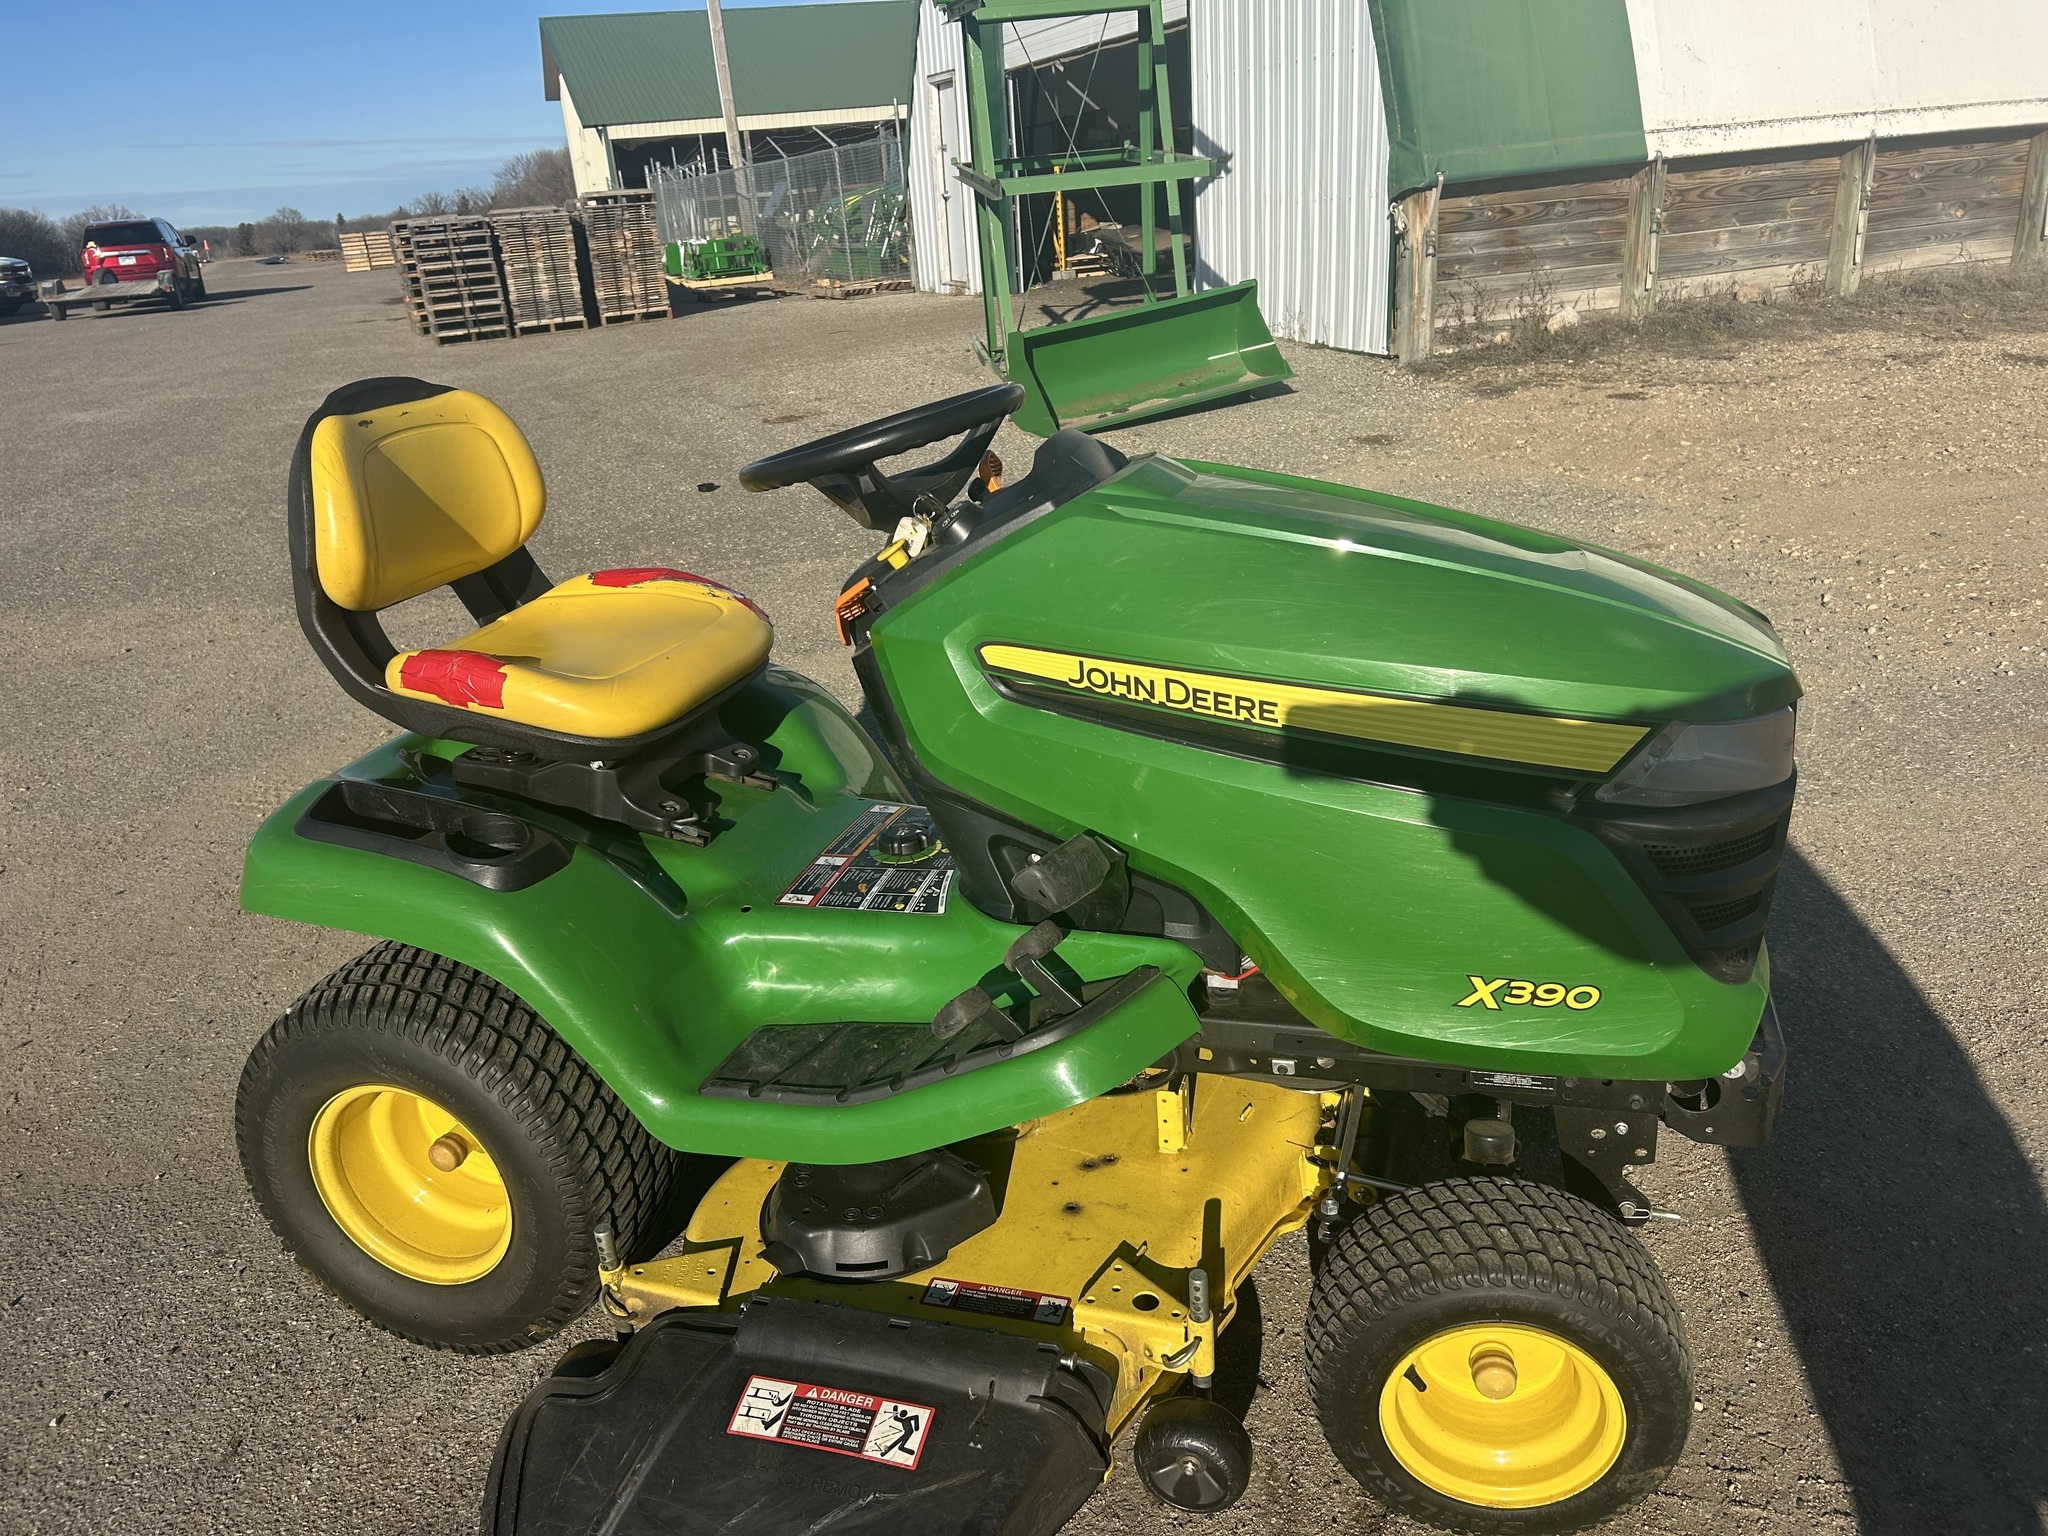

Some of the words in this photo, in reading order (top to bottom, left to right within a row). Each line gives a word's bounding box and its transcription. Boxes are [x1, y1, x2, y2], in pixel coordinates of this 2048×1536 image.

[1068, 660, 1155, 700] JOHN
[1165, 677, 1279, 723] DEERE
[1452, 975, 1602, 1011] X390
[987, 1286, 1023, 1296] DANGER
[820, 1389, 874, 1407] DANGER
[806, 1399, 838, 1409] ROTATING
[839, 1405, 861, 1413] BLADE
[799, 1412, 827, 1421] THROWN
[828, 1417, 858, 1427] OBJECTS
[801, 1429, 822, 1437] OPERATE
[839, 1436, 860, 1444] WITHOUT
